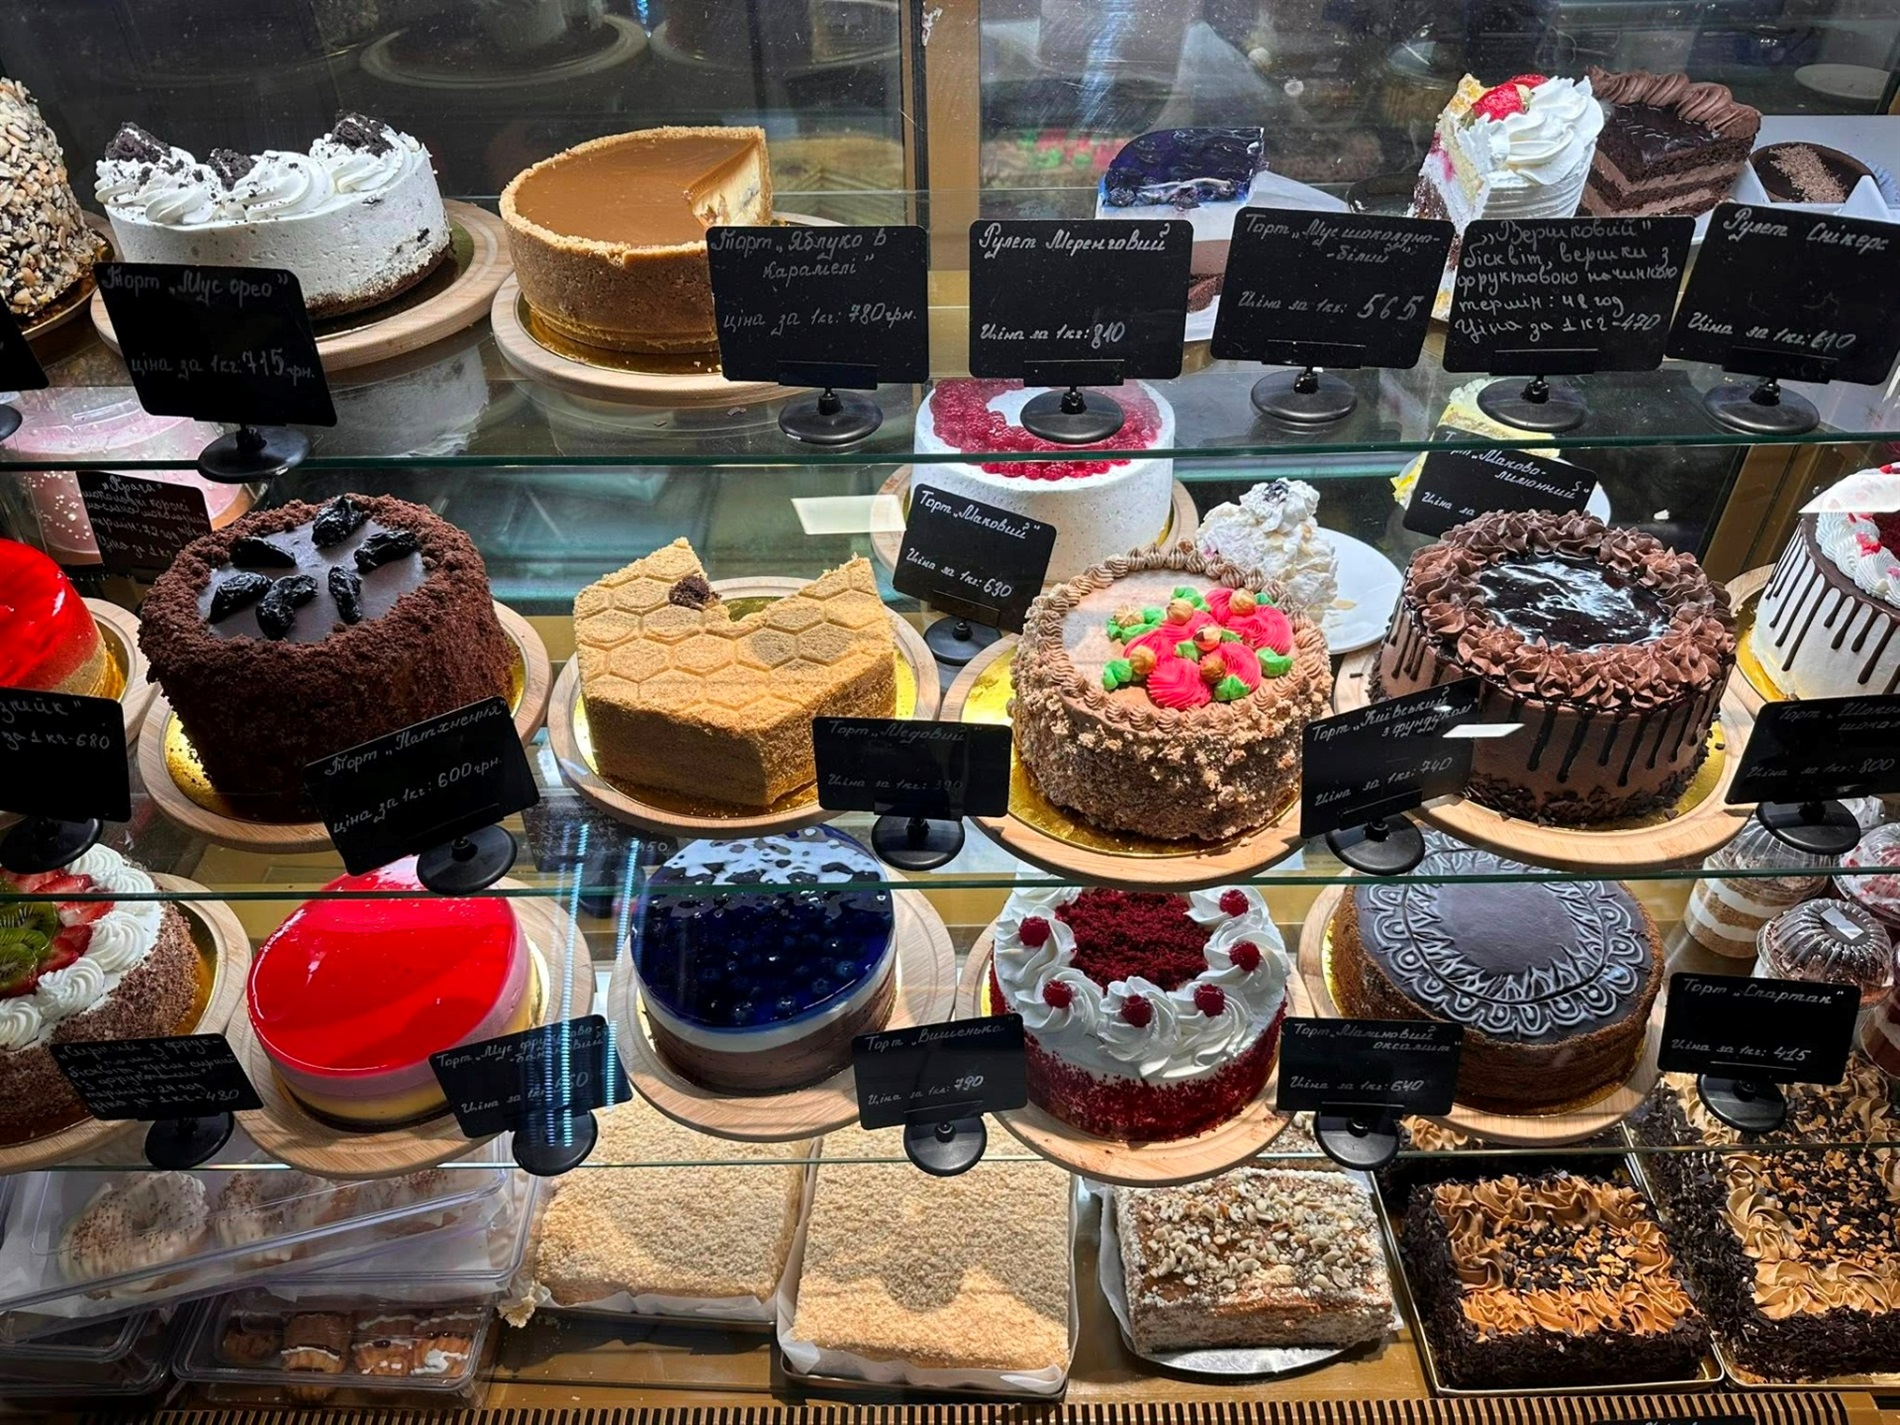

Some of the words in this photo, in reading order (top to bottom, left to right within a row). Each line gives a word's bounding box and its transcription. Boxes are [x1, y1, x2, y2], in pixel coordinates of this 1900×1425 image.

[1245, 213, 1291, 240] Торт
[1723, 207, 1789, 242] Рулет
[1806, 222, 1890, 255] Снікерс
[710, 229, 772, 258] Торт
[978, 222, 1036, 260] Рулет
[1045, 222, 1170, 257] Меренговий
[1560, 242, 1648, 271] вершки
[1660, 246, 1670, 268] з
[102, 266, 160, 298] Торт
[1457, 266, 1578, 297] фруктовою
[1238, 290, 1281, 308] Ціна
[1288, 300, 1308, 312] за
[1356, 293, 1425, 321] 565
[1561, 294, 1588, 309] 48
[1594, 294, 1624, 318] год
[723, 309, 766, 333] ціна
[770, 312, 800, 336] за
[979, 323, 1025, 341] Ціна
[1029, 329, 1049, 340] за
[1091, 321, 1126, 350] 810
[1454, 318, 1523, 344] Ціна
[1529, 321, 1554, 342] за
[1687, 311, 1734, 335] Ціна
[1745, 325, 1770, 339] за
[131, 352, 173, 377] ціна
[178, 358, 206, 381] за
[919, 490, 952, 514] Торт
[1421, 491, 1453, 510] Ціна
[1458, 507, 1476, 516] за
[906, 547, 936, 570] Ціна
[940, 566, 955, 577] за
[983, 578, 1013, 598] 630
[1779, 703, 1821, 723] Торт
[828, 720, 869, 738] Торт
[1312, 723, 1353, 741] Торт
[1381, 726, 1389, 737] з
[324, 749, 377, 776] Торт
[1745, 766, 1788, 779] Ціна
[1799, 766, 1819, 775] за
[1859, 757, 1896, 775] 800
[828, 773, 866, 787] Ціна
[875, 780, 890, 788] за
[1314, 788, 1352, 807] Ціна
[1361, 779, 1380, 792] за
[1420, 756, 1453, 774] 740
[333, 810, 373, 834] ціна
[373, 798, 399, 823] за
[1683, 978, 1727, 996] Торт
[1294, 1023, 1330, 1037] Торт
[865, 1035, 903, 1053] Торт
[1671, 1039, 1711, 1052] Ціна
[1716, 1045, 1735, 1053] за
[1773, 1046, 1812, 1061] 415
[436, 1052, 472, 1069] Торт
[868, 1093, 902, 1106] Ціна
[909, 1090, 924, 1099] за
[954, 1075, 984, 1091] 790
[1289, 1075, 1329, 1089] Ціна
[1337, 1082, 1355, 1090] за
[1390, 1080, 1425, 1092] 640
[461, 1099, 499, 1114] Ціна
[506, 1094, 521, 1104] за
